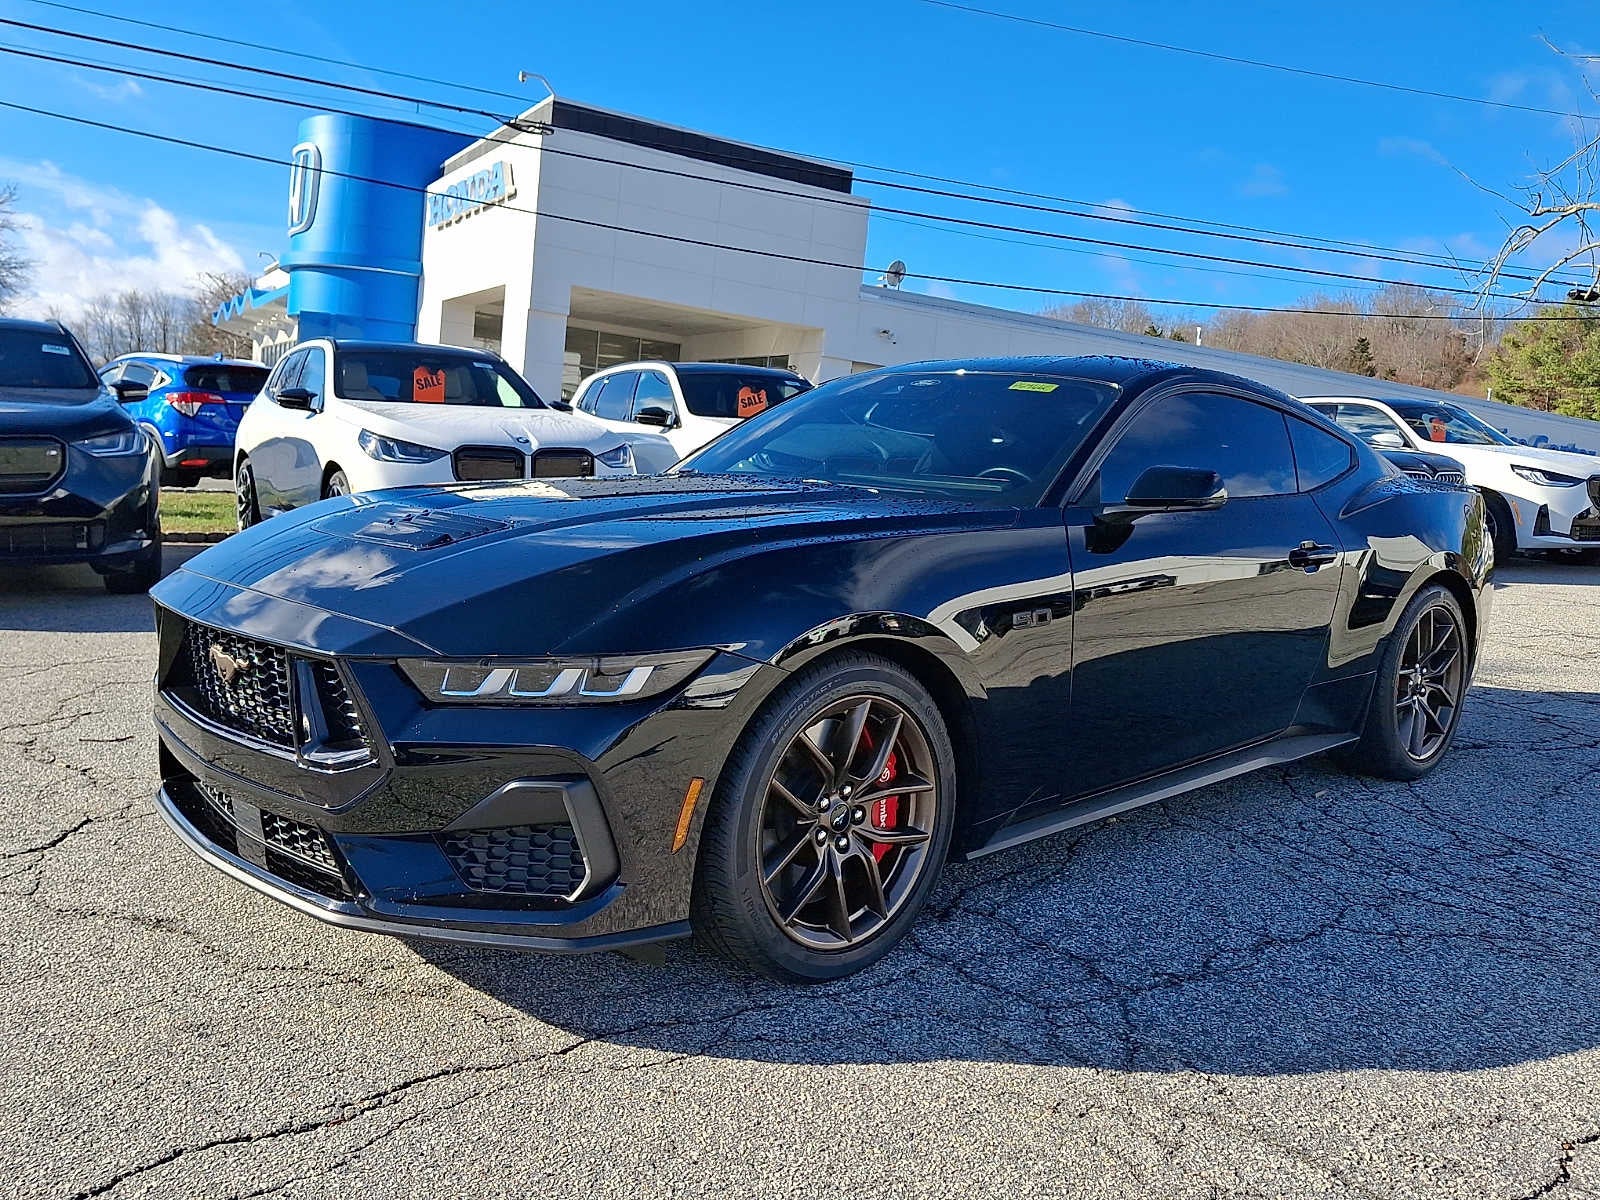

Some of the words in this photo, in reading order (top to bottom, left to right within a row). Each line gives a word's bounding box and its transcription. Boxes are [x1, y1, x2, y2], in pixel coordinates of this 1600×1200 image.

[428, 160, 507, 227] HONDA
[416, 375, 443, 390] SALE
[740, 393, 764, 408] SALE
